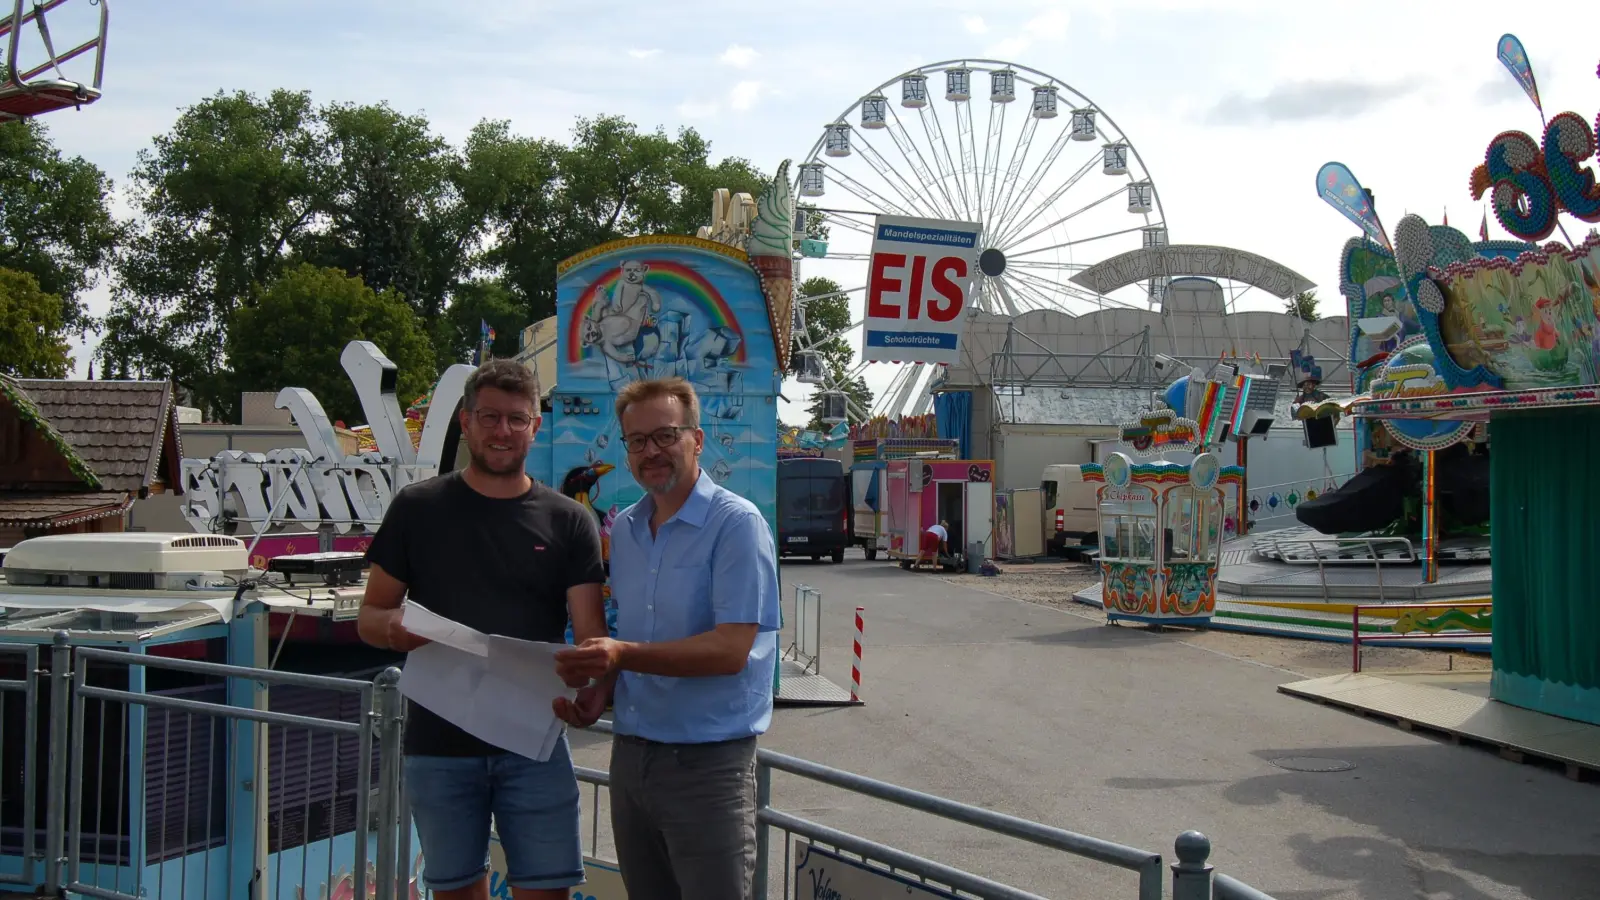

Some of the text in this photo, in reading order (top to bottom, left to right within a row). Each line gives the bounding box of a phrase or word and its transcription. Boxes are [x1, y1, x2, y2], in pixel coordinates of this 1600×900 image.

[884, 228, 972, 244] Mandelspezialitäten
[868, 252, 968, 322] EIS
[884, 335, 940, 345] Schokofrüchte
